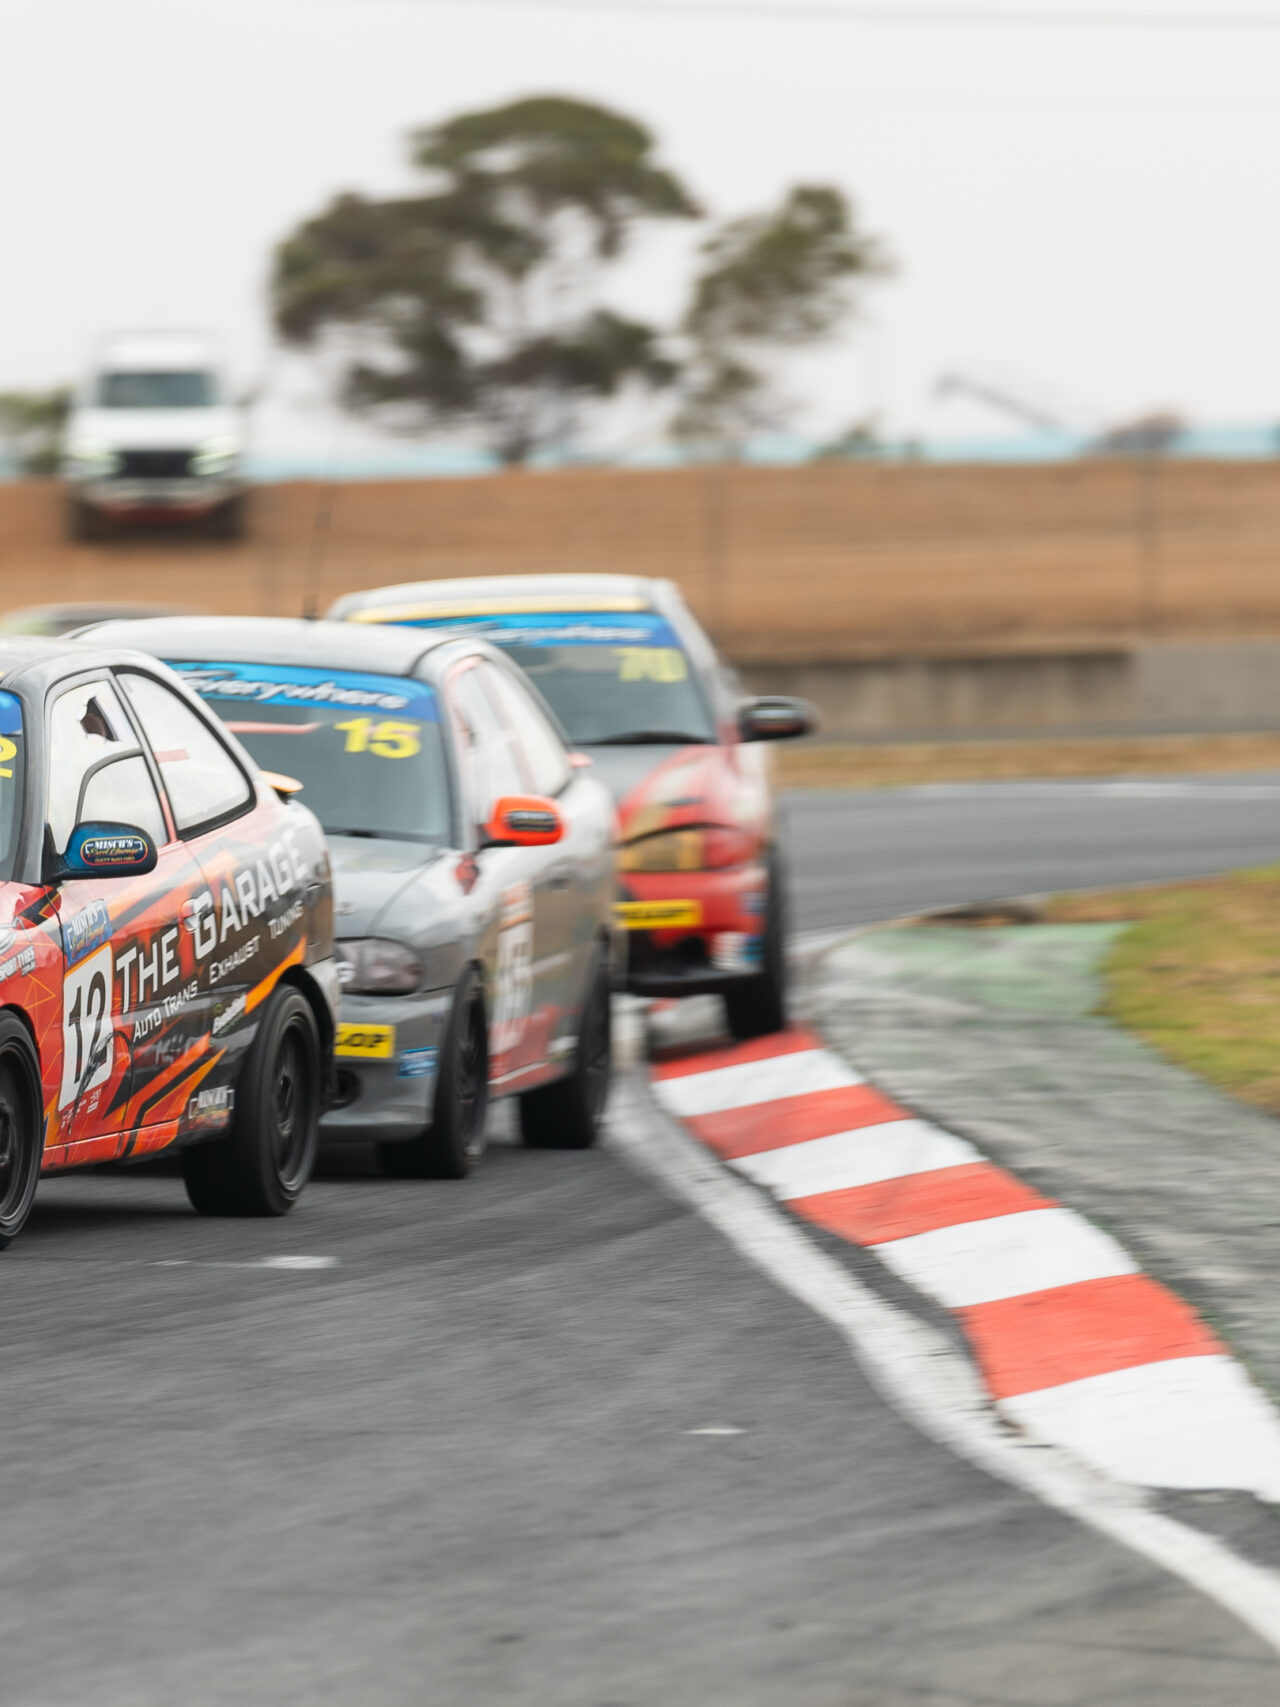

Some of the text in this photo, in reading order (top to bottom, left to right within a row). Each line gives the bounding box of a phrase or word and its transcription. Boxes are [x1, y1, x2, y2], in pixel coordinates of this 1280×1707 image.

[333, 717, 421, 759] 15
[116, 828, 309, 1014] THE GARAGE
[69, 970, 107, 1084] 12
[133, 1008, 162, 1042] AUTO
[163, 980, 199, 1017] TRANS
